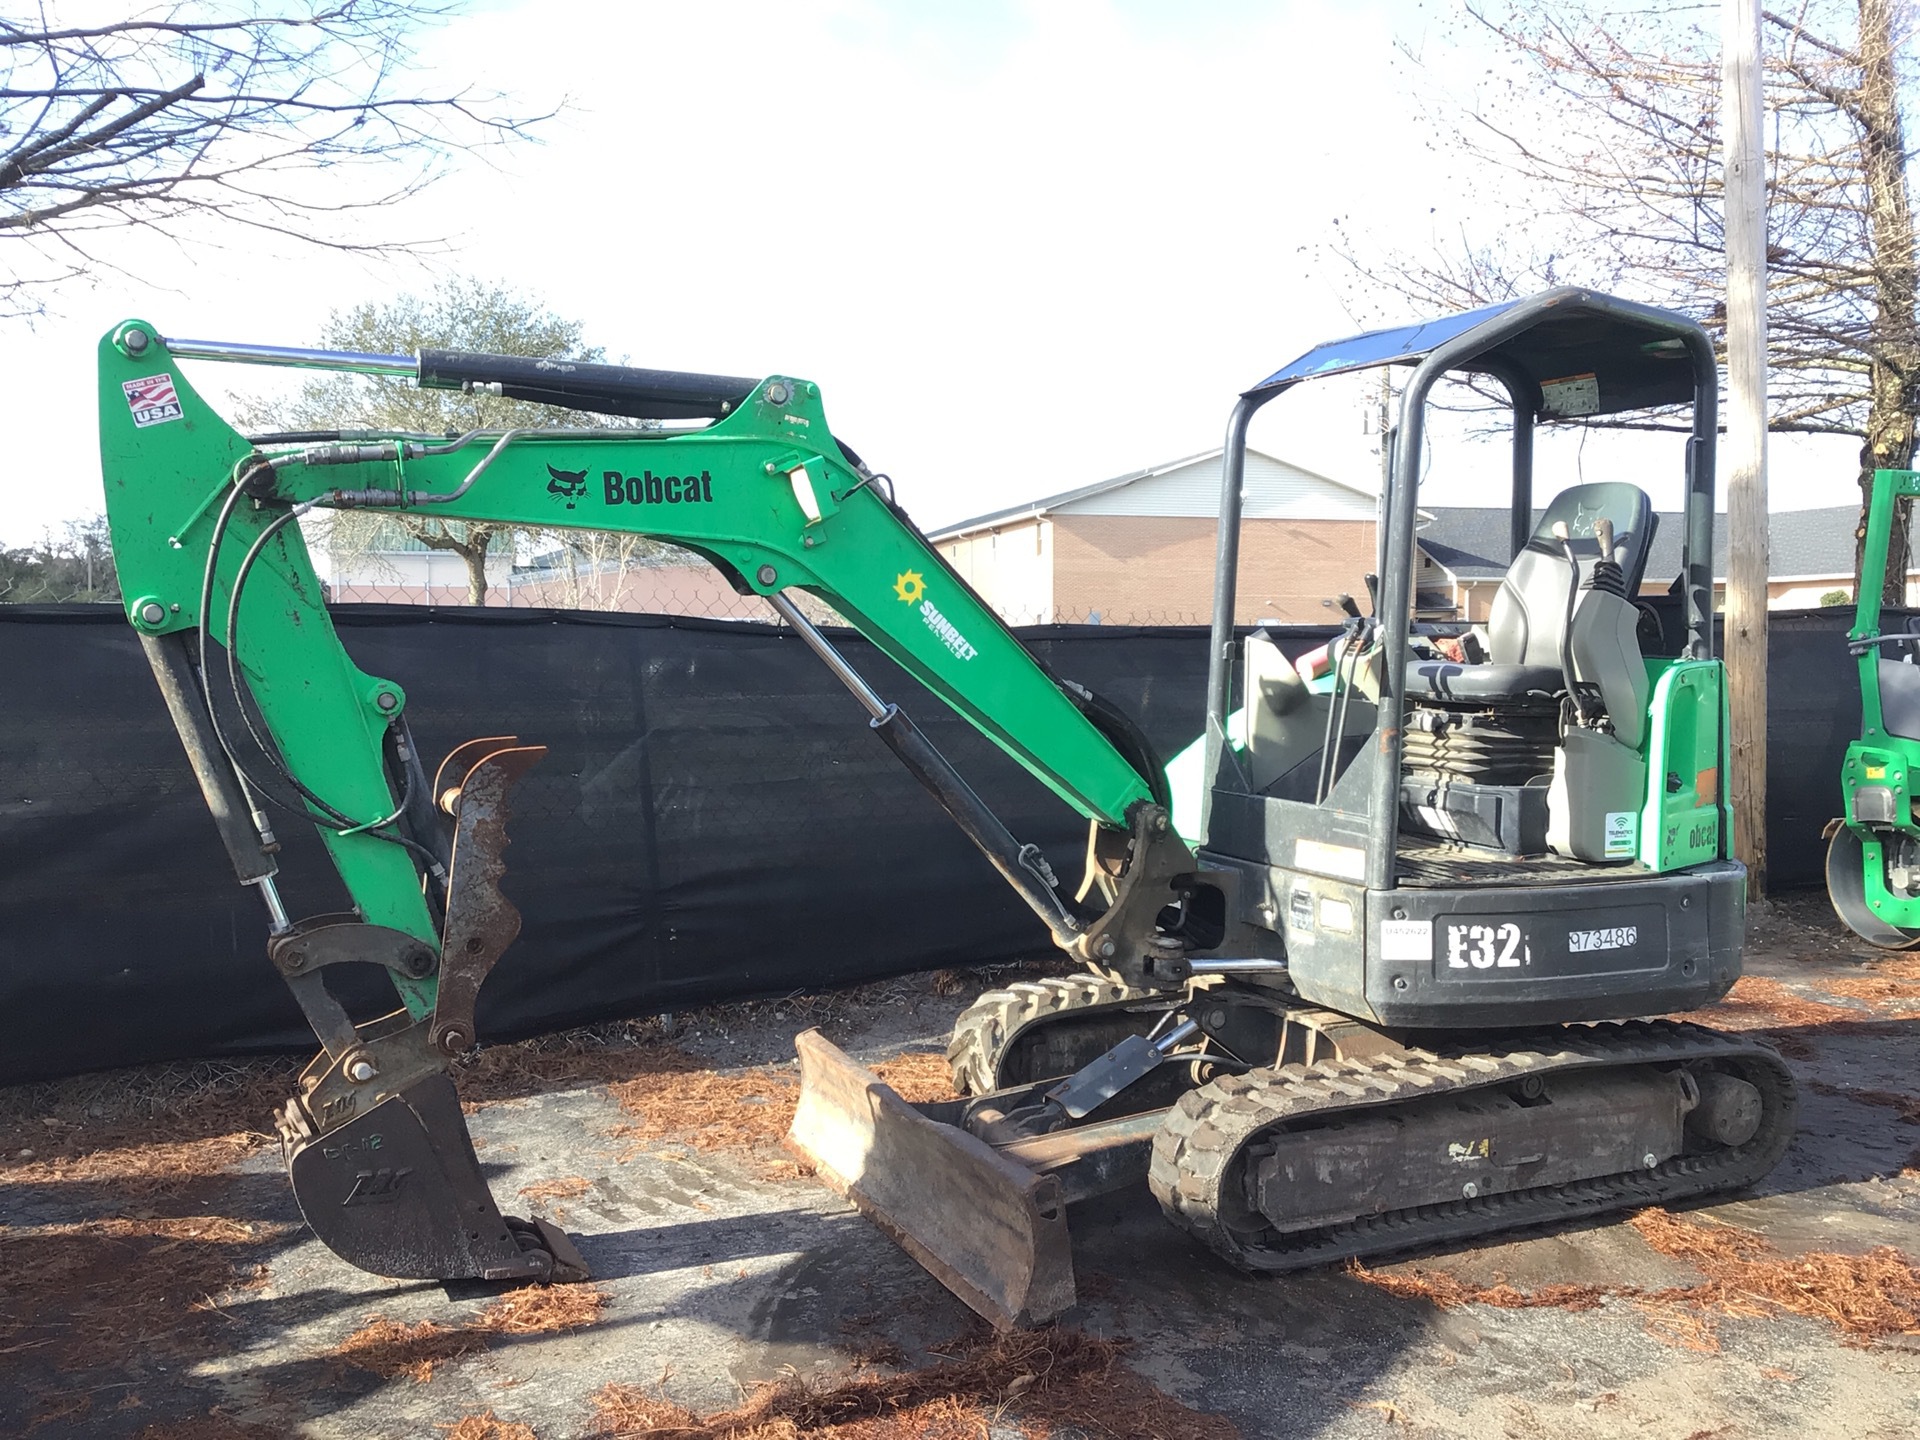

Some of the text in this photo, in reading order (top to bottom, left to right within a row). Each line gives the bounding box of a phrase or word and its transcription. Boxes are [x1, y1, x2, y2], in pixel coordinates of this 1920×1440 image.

[126, 381, 145, 390] MADE
[136, 404, 178, 422] USA
[603, 470, 713, 505] Bobcat
[919, 600, 978, 661] SUNBELT
[922, 616, 962, 659] RENTALS
[1569, 927, 1636, 950] 973486
